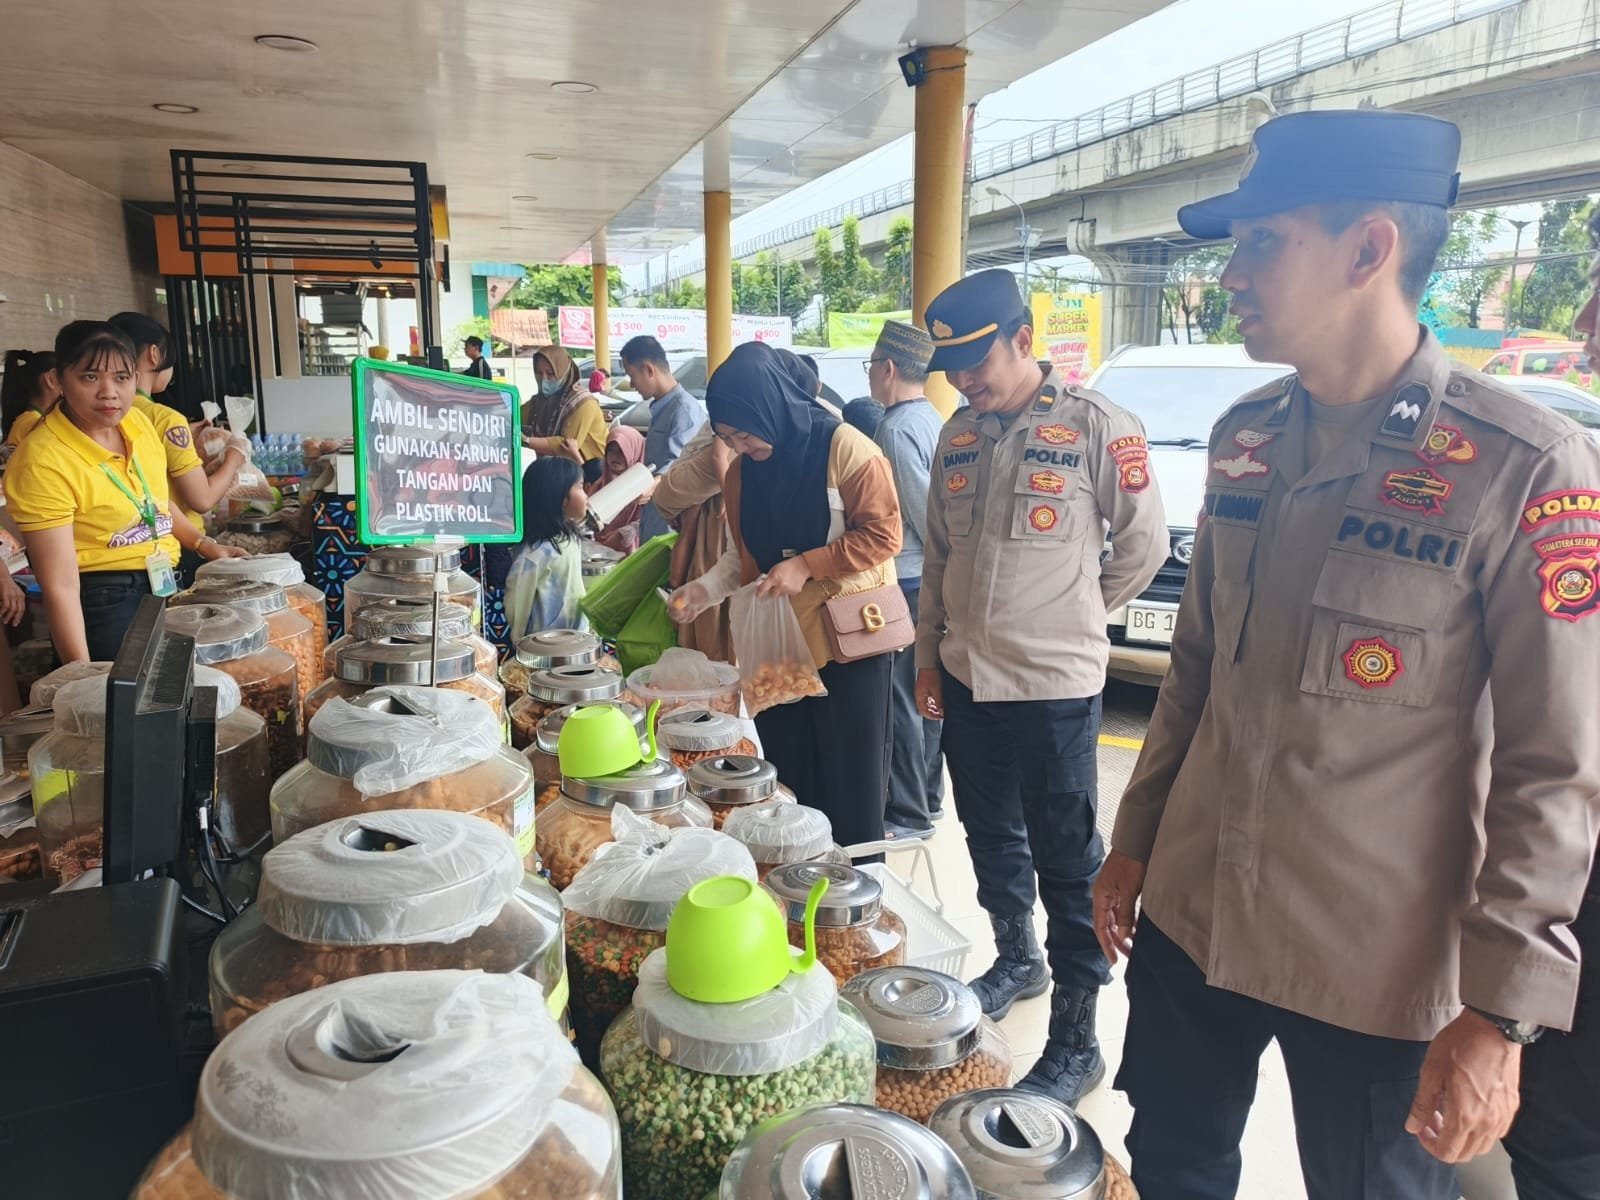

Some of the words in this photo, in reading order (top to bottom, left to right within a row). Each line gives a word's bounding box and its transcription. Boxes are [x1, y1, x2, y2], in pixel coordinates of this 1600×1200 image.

[1048, 311, 1089, 324] SUPER
[1047, 322, 1089, 335] MARKET
[370, 398, 433, 430] AMBIL
[438, 407, 506, 438] SENDIRI
[374, 434, 450, 460] GUNAKAN
[454, 442, 509, 464] SARUNG
[1112, 437, 1144, 451] POLDA
[944, 450, 980, 468] DANNY
[1023, 448, 1081, 468] POLRI
[396, 469, 459, 491] TANGAN
[463, 474, 492, 493] DAN
[396, 503, 454, 522] PLASTIK
[458, 504, 492, 523] ROLL
[1525, 495, 1600, 524] POLDA
[1338, 515, 1460, 567] POLRI
[1134, 610, 1155, 629] BG
